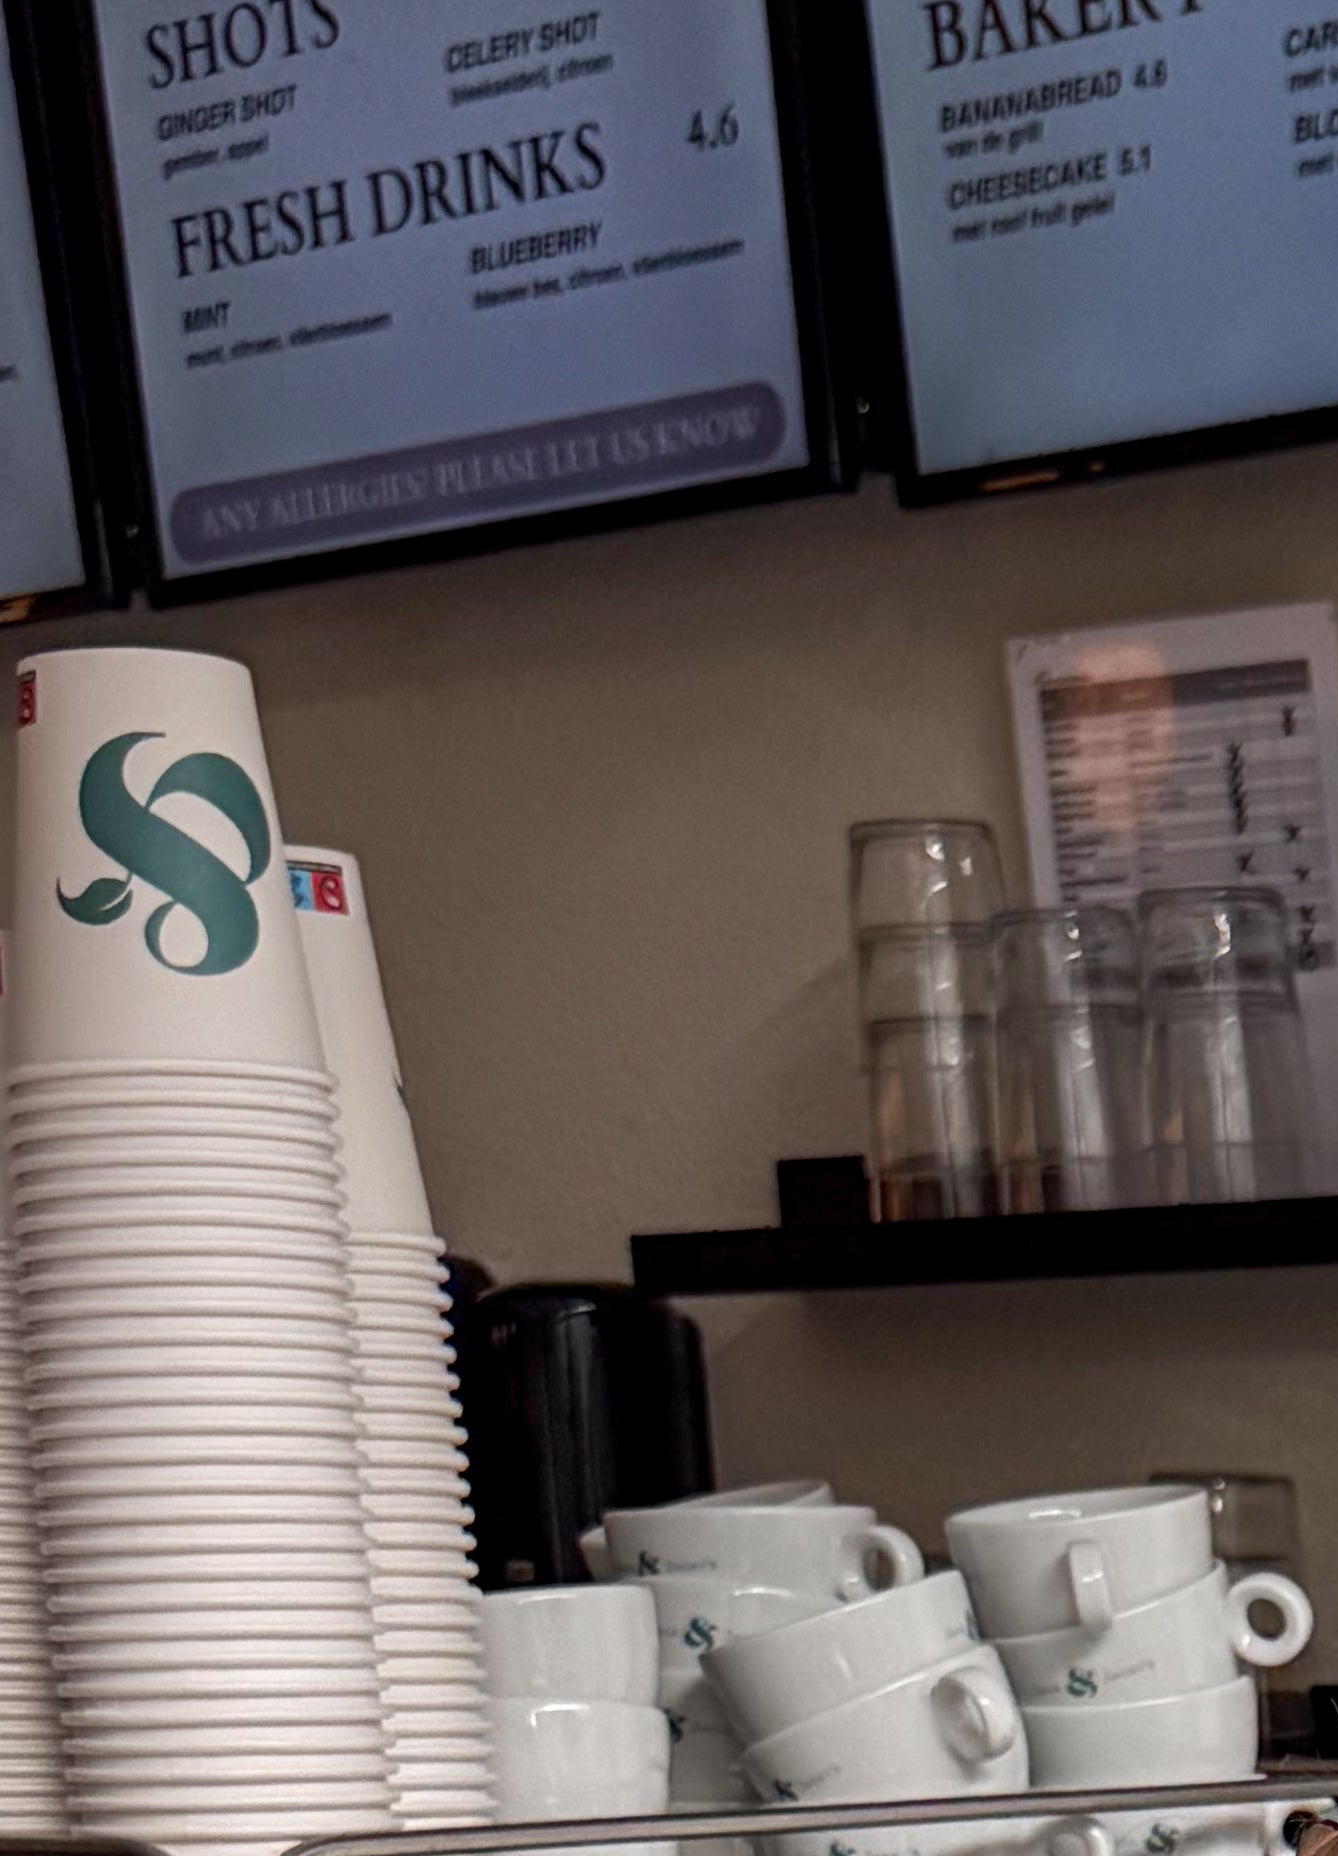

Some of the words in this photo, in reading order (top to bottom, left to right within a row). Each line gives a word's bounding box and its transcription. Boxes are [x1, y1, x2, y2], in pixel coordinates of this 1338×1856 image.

[146, 0, 340, 89] SHOTS
[445, 27, 534, 73] CELERY
[538, 11, 600, 52] SHOT
[923, 0, 1204, 70] BAKE
[158, 97, 236, 141] GINGER
[240, 84, 297, 122] SHOT
[940, 67, 1122, 133] BANANABREAD
[170, 179, 355, 279] FRESH
[366, 121, 607, 237] DRINKS
[688, 103, 739, 151] 4.6
[947, 150, 1108, 210] CHEESECAKE
[471, 221, 603, 274] BLUEBERRY
[183, 298, 231, 334] MINT
[201, 496, 262, 541] ANY
[543, 434, 602, 477] LET
[651, 404, 761, 456] KNOW
